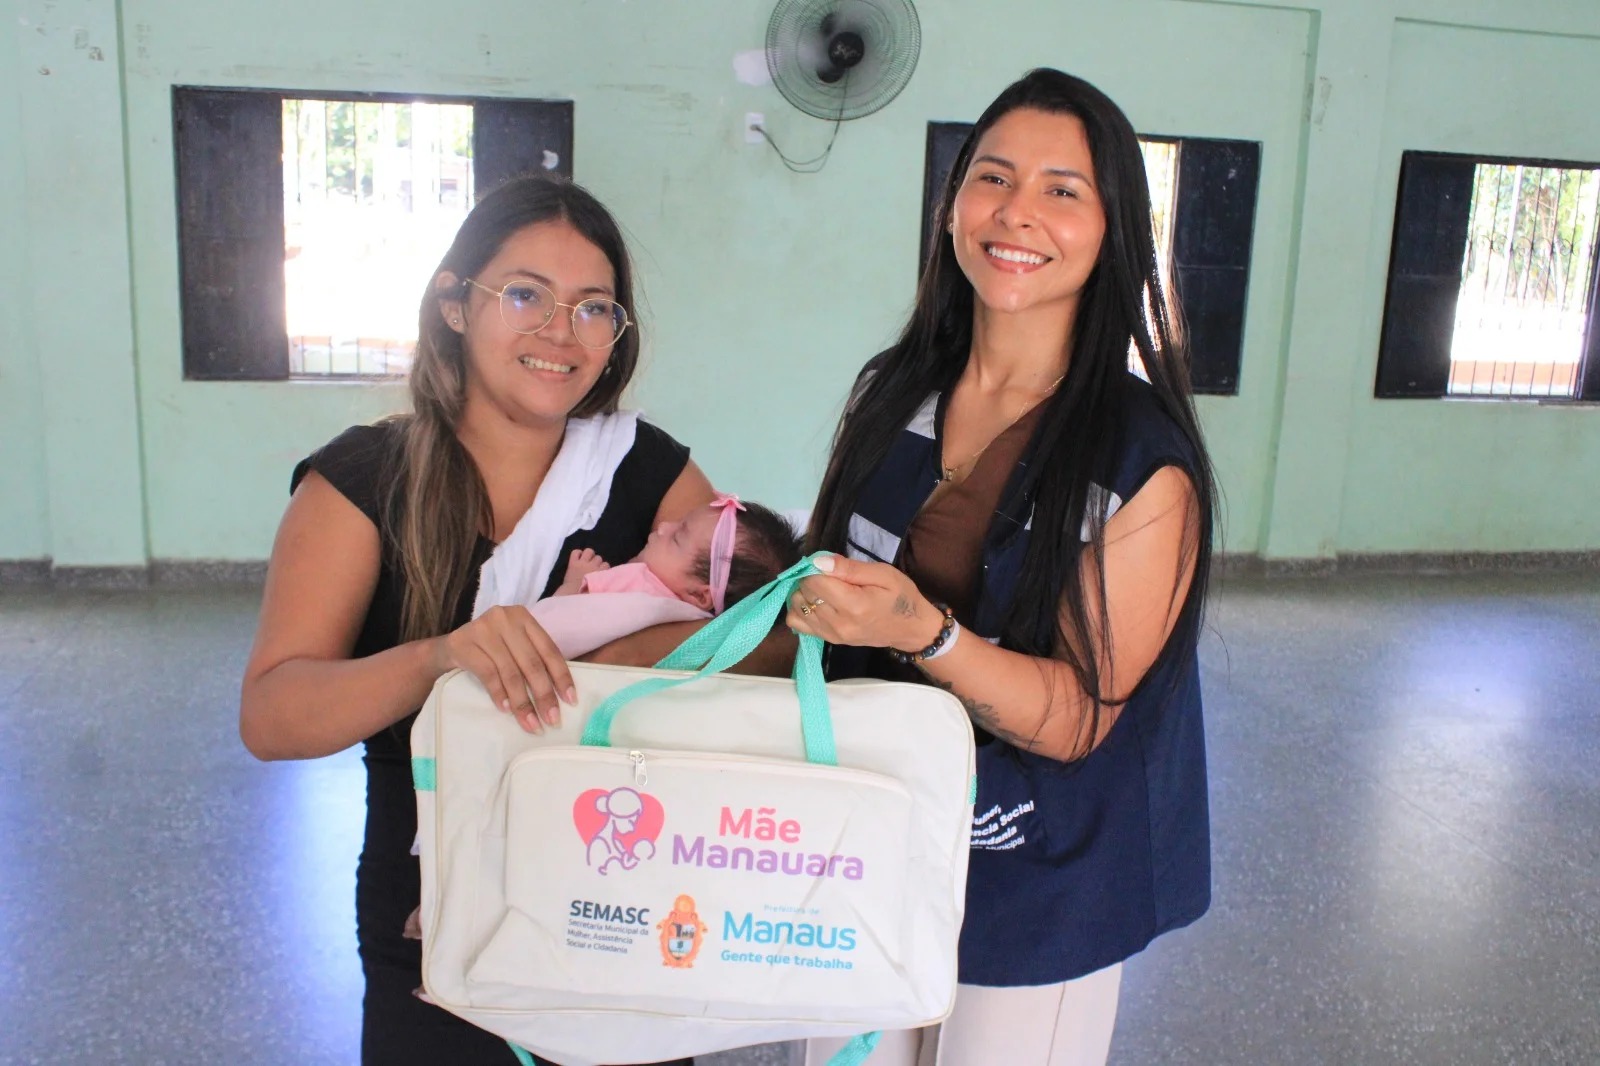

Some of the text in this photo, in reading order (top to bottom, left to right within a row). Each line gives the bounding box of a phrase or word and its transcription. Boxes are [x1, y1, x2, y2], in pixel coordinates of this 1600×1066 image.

[719, 806, 801, 843] Mãe
[999, 800, 1034, 826] Social
[672, 834, 864, 880] Manauara
[570, 900, 650, 926] SEMASC
[567, 929, 633, 944] Mulher, Assistência
[568, 919, 649, 936] Secretaria Municipal da
[722, 910, 857, 951] Manaus
[566, 938, 586, 948] Social
[593, 942, 628, 954] Cidadania
[721, 949, 853, 970] Gente que trabalha
